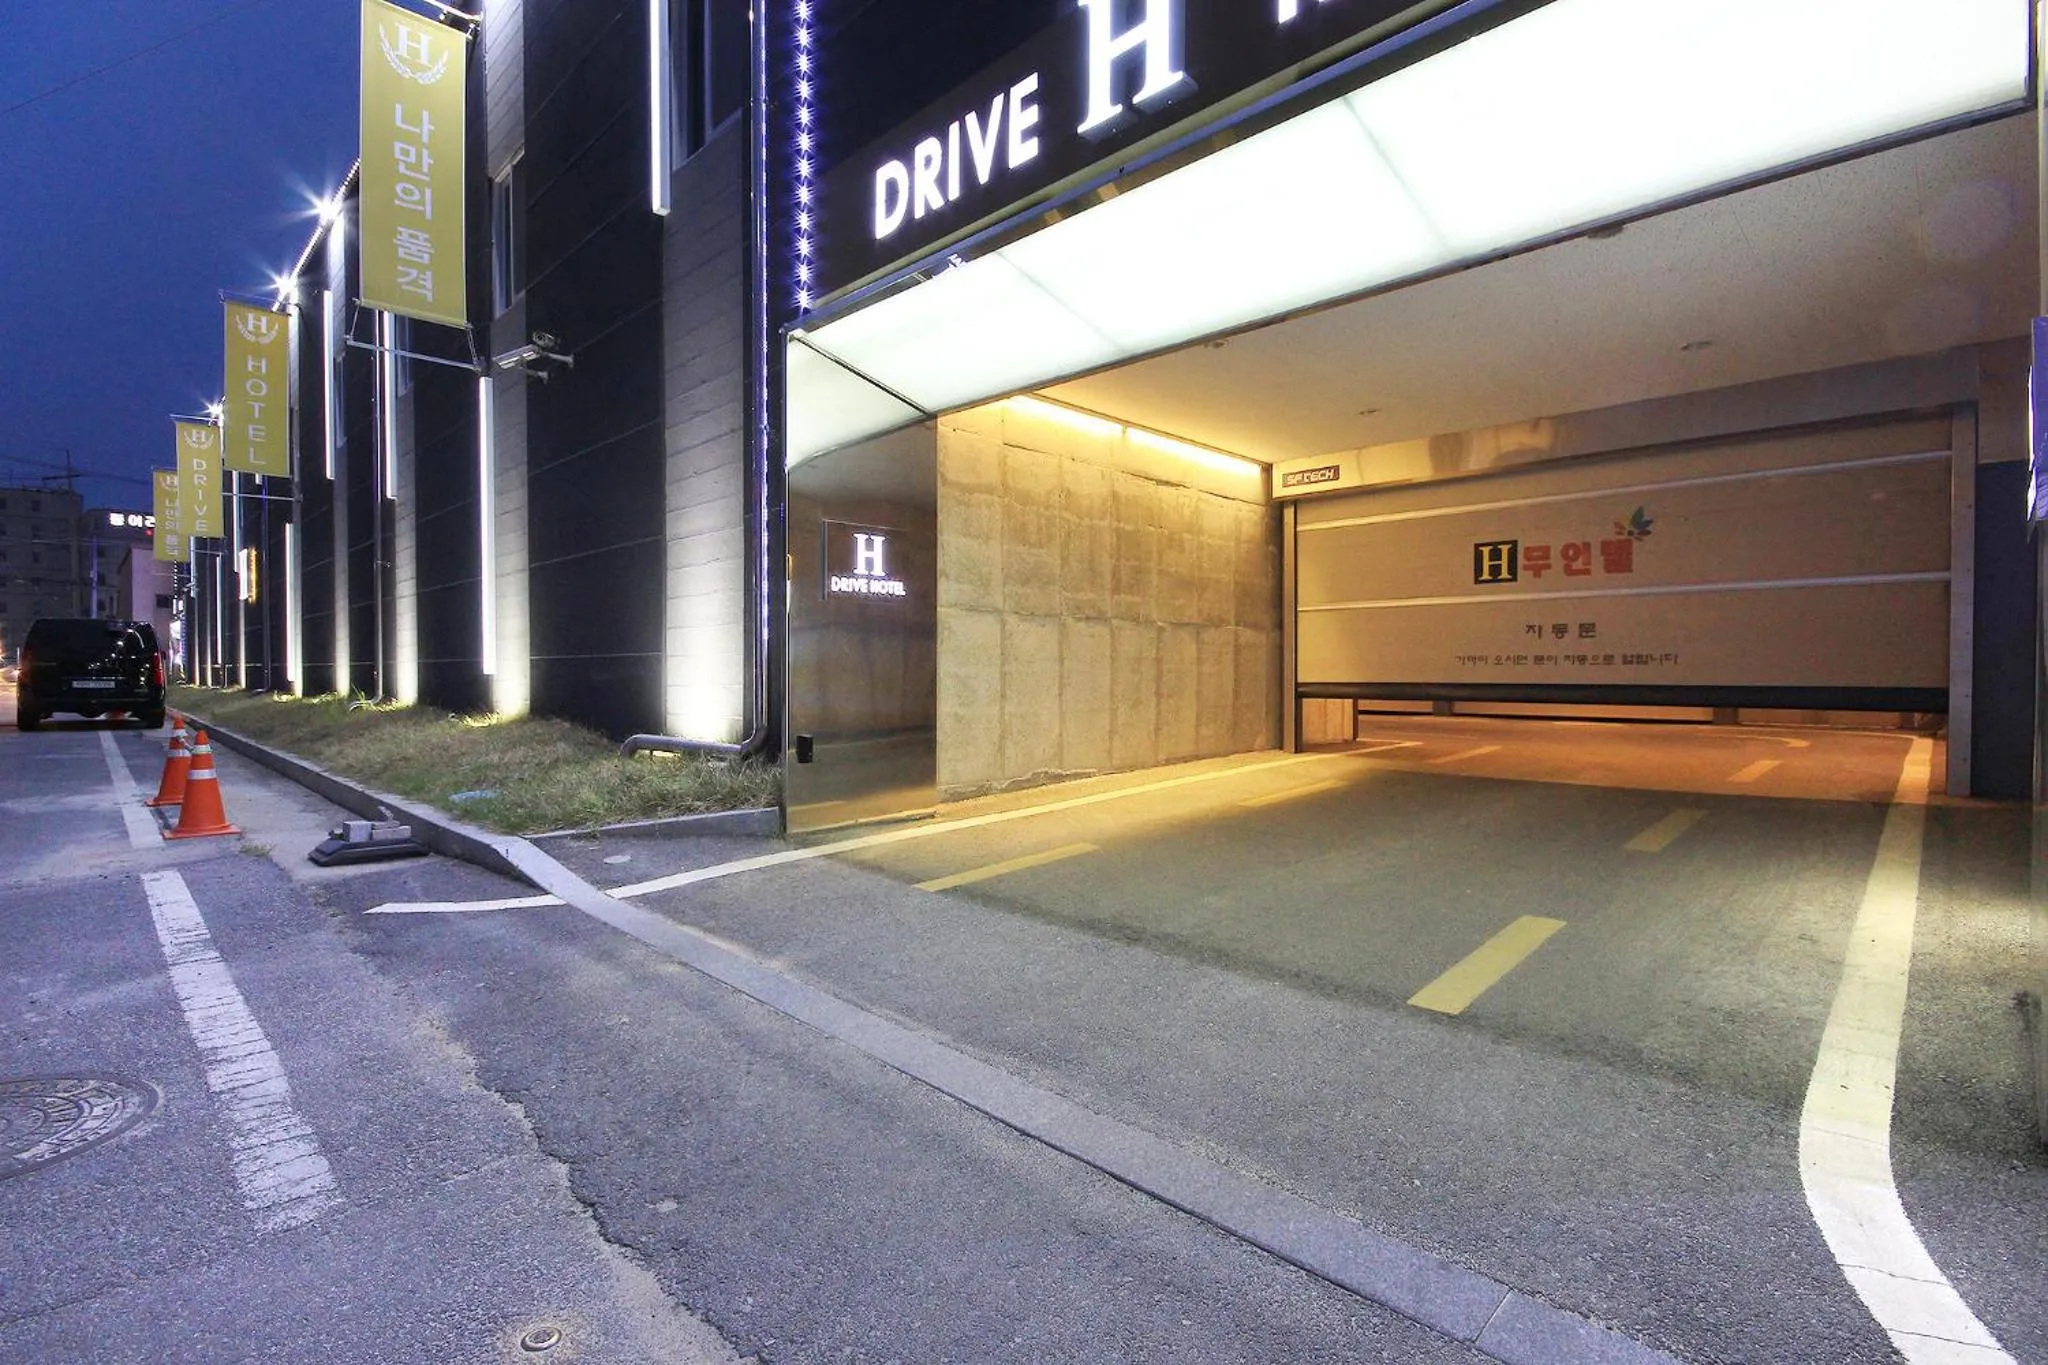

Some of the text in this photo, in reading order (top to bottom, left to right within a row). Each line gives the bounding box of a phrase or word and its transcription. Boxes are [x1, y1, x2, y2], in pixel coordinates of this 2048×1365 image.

[396, 22, 433, 67] H
[1076, 0, 1186, 134] H
[874, 71, 1040, 242] DRIVE
[394, 104, 435, 302] 나만의 품격
[246, 313, 267, 334] H
[246, 355, 268, 465] HOTEL
[193, 457, 208, 532] DRIVE
[853, 533, 887, 577] H
[1478, 543, 1513, 580] H
[831, 575, 906, 596] DRIVE HOTEL
